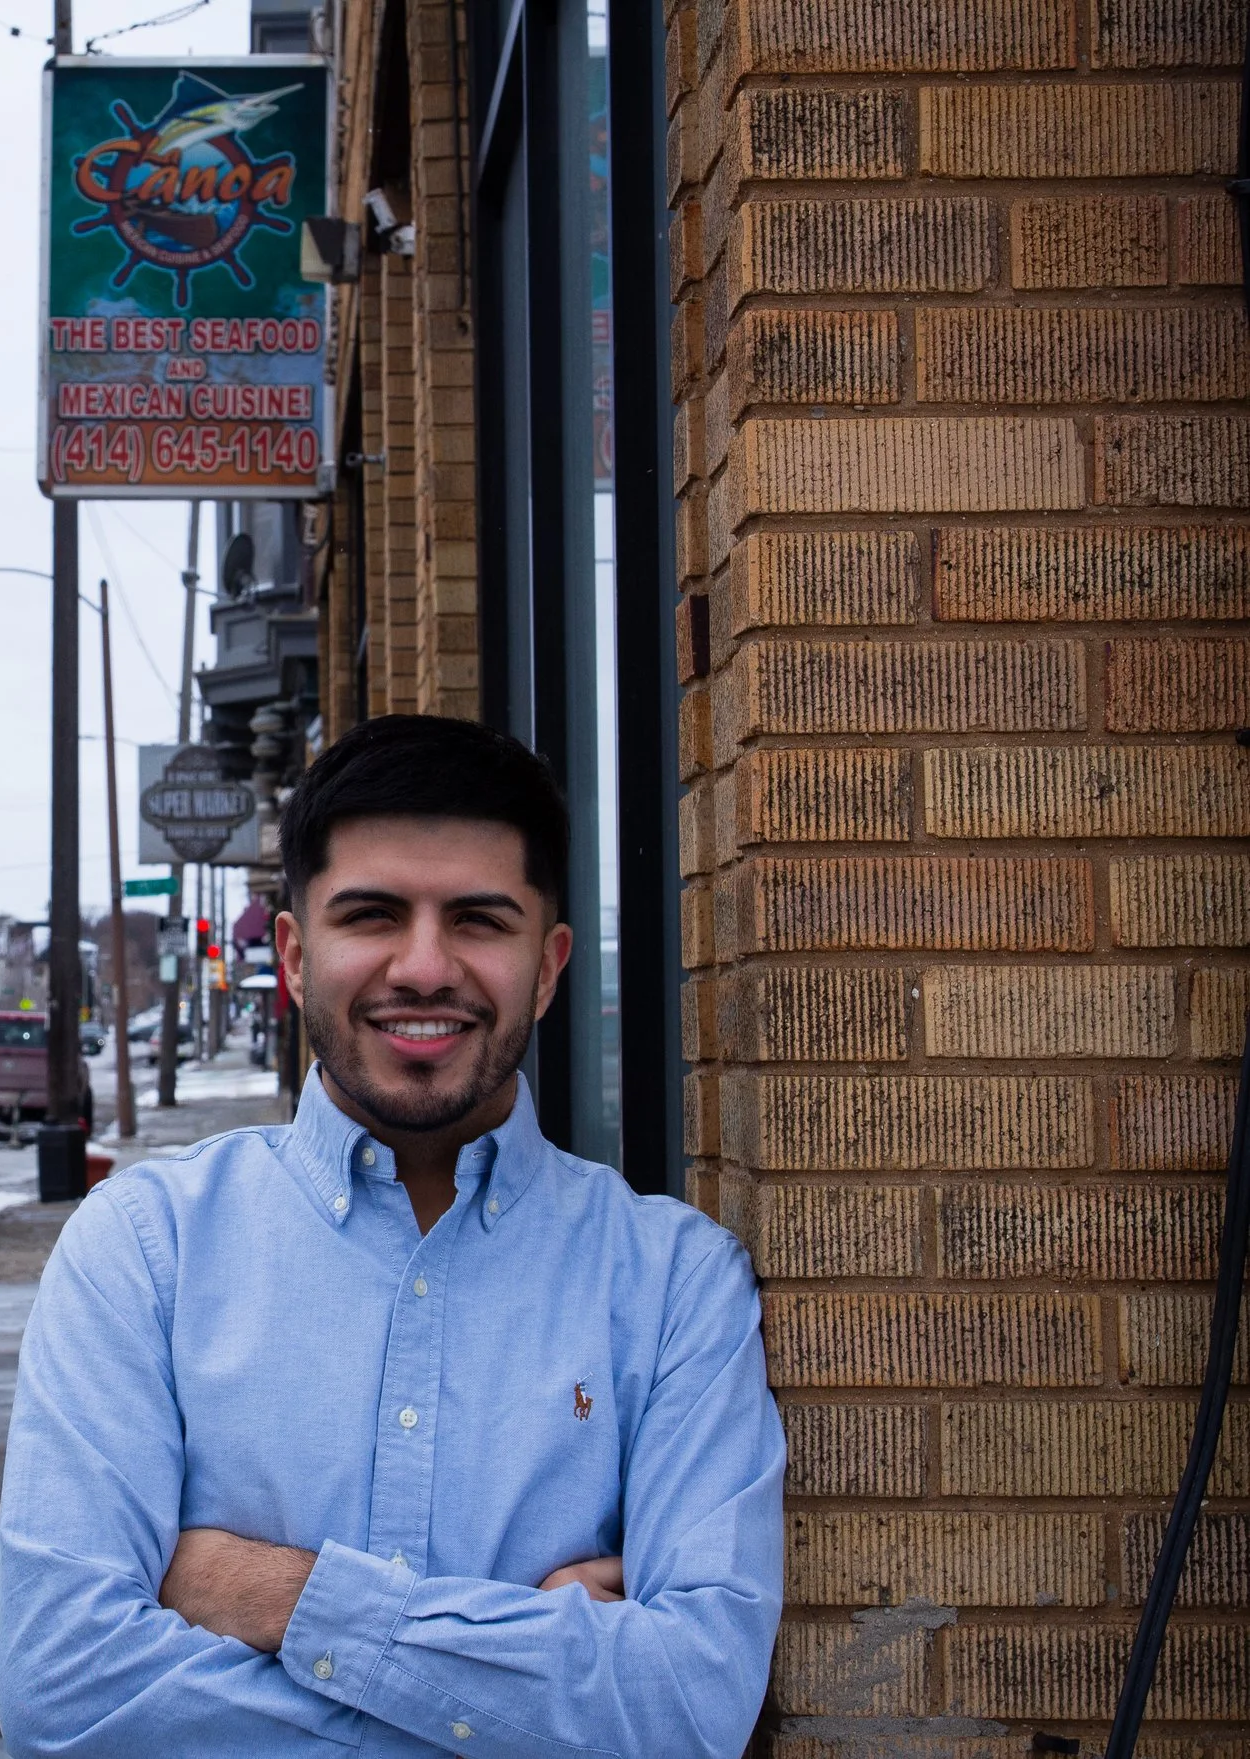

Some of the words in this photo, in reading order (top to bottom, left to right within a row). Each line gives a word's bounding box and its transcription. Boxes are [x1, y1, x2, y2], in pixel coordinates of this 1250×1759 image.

[77, 139, 295, 206] Canoa
[52, 318, 104, 351] THE
[114, 319, 184, 351] BEST
[190, 319, 320, 352] SEAFOOD
[166, 358, 206, 379] AND
[59, 383, 185, 418] MEXICAN
[190, 384, 312, 418] CUISINE!
[52, 425, 144, 482] (414)
[153, 426, 319, 473] 645-1140
